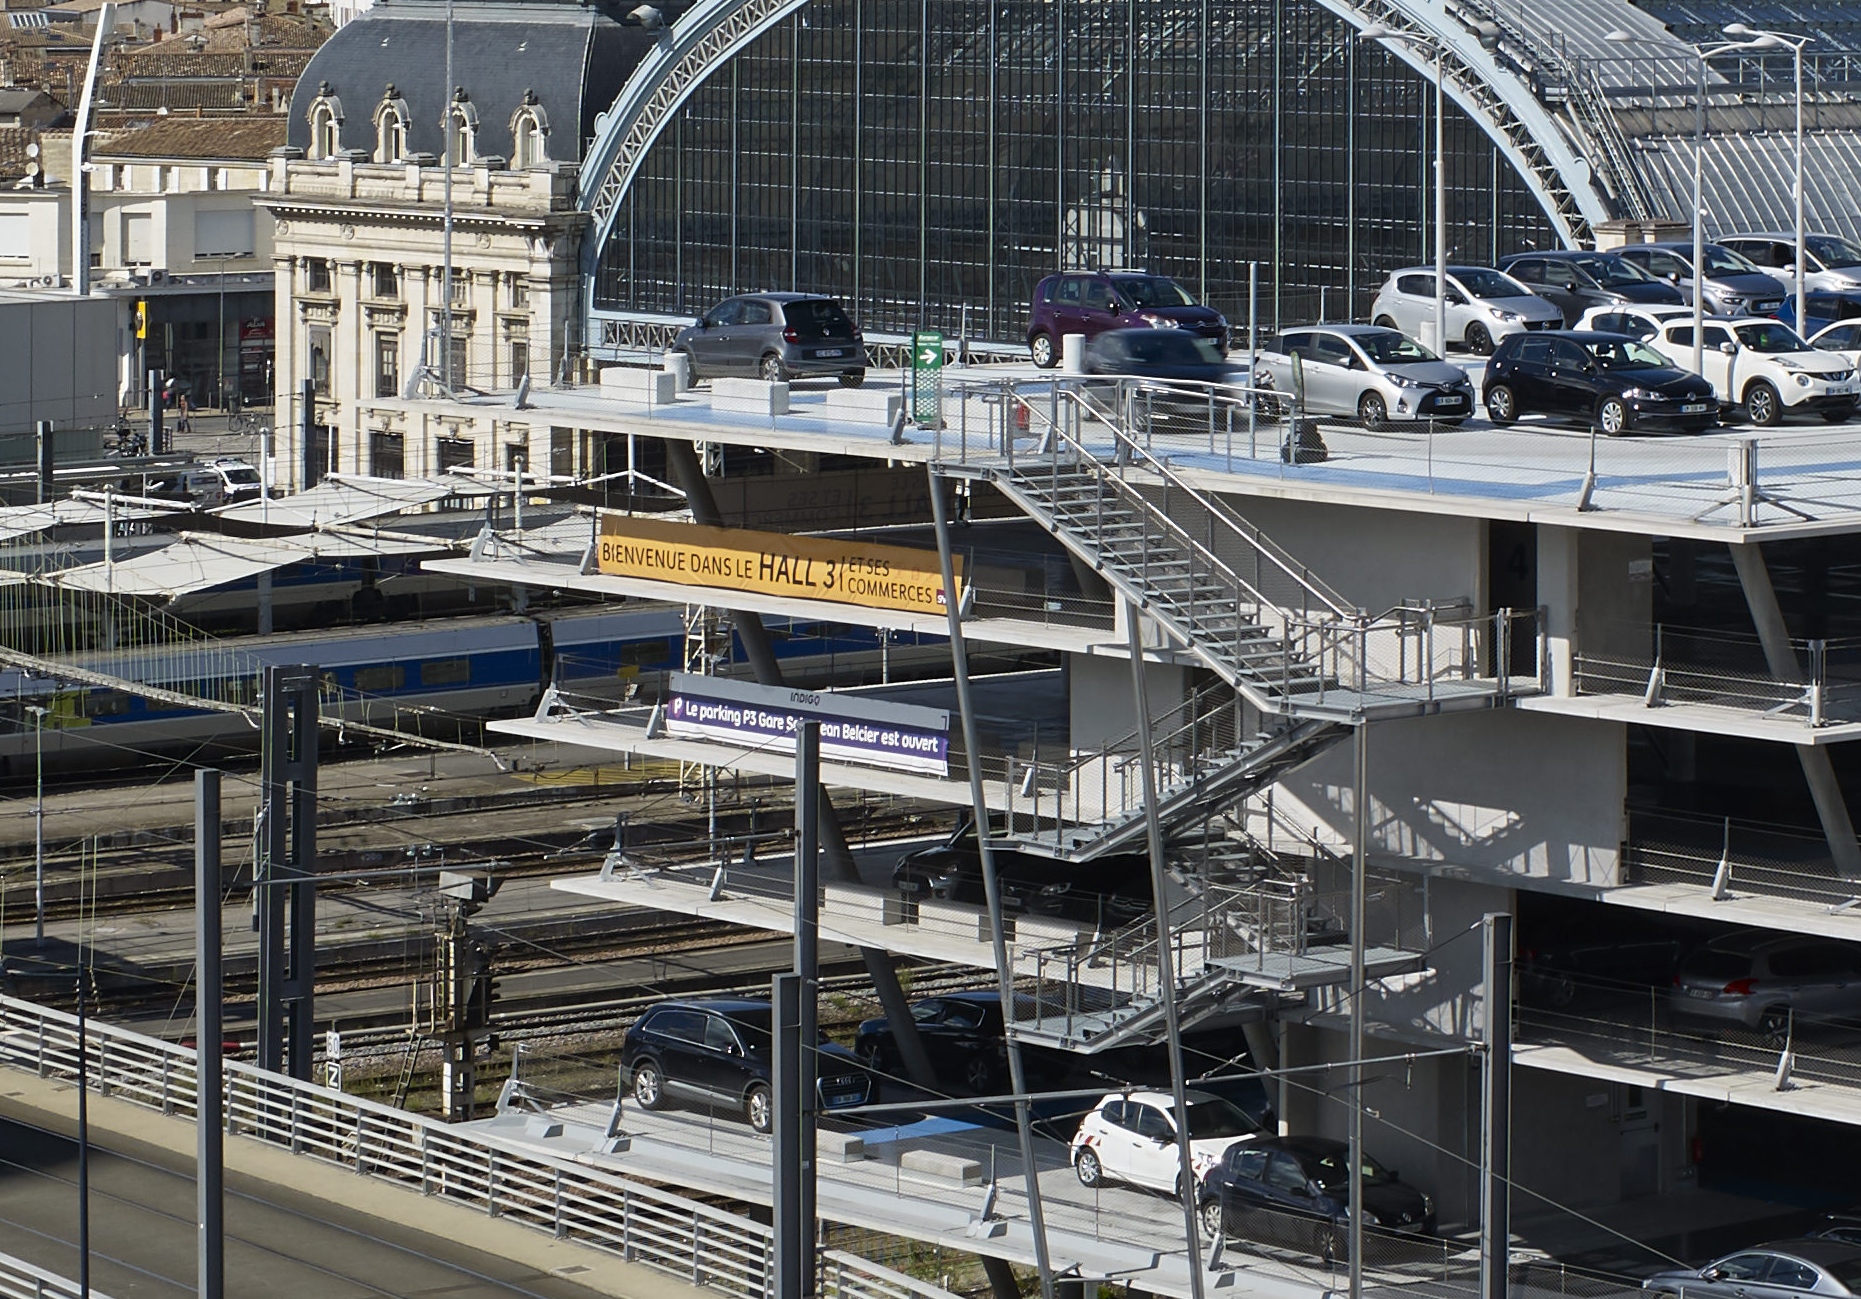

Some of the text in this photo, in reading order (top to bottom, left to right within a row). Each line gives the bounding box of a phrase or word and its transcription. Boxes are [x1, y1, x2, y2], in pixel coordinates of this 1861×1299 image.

[602, 542, 836, 590] BIENVENUE DANS LE HALL 3
[848, 556, 890, 577] ET SES
[847, 577, 933, 605] COMMERCES
[686, 701, 697, 718] Le
[699, 703, 741, 727] parking
[742, 710, 757, 726] P3
[759, 712, 784, 730] Gare
[842, 723, 878, 745] Belcier
[881, 729, 900, 747] est
[902, 734, 939, 753] ouvert
[328, 1035, 338, 1054] 60
[328, 1066, 338, 1087] Z
